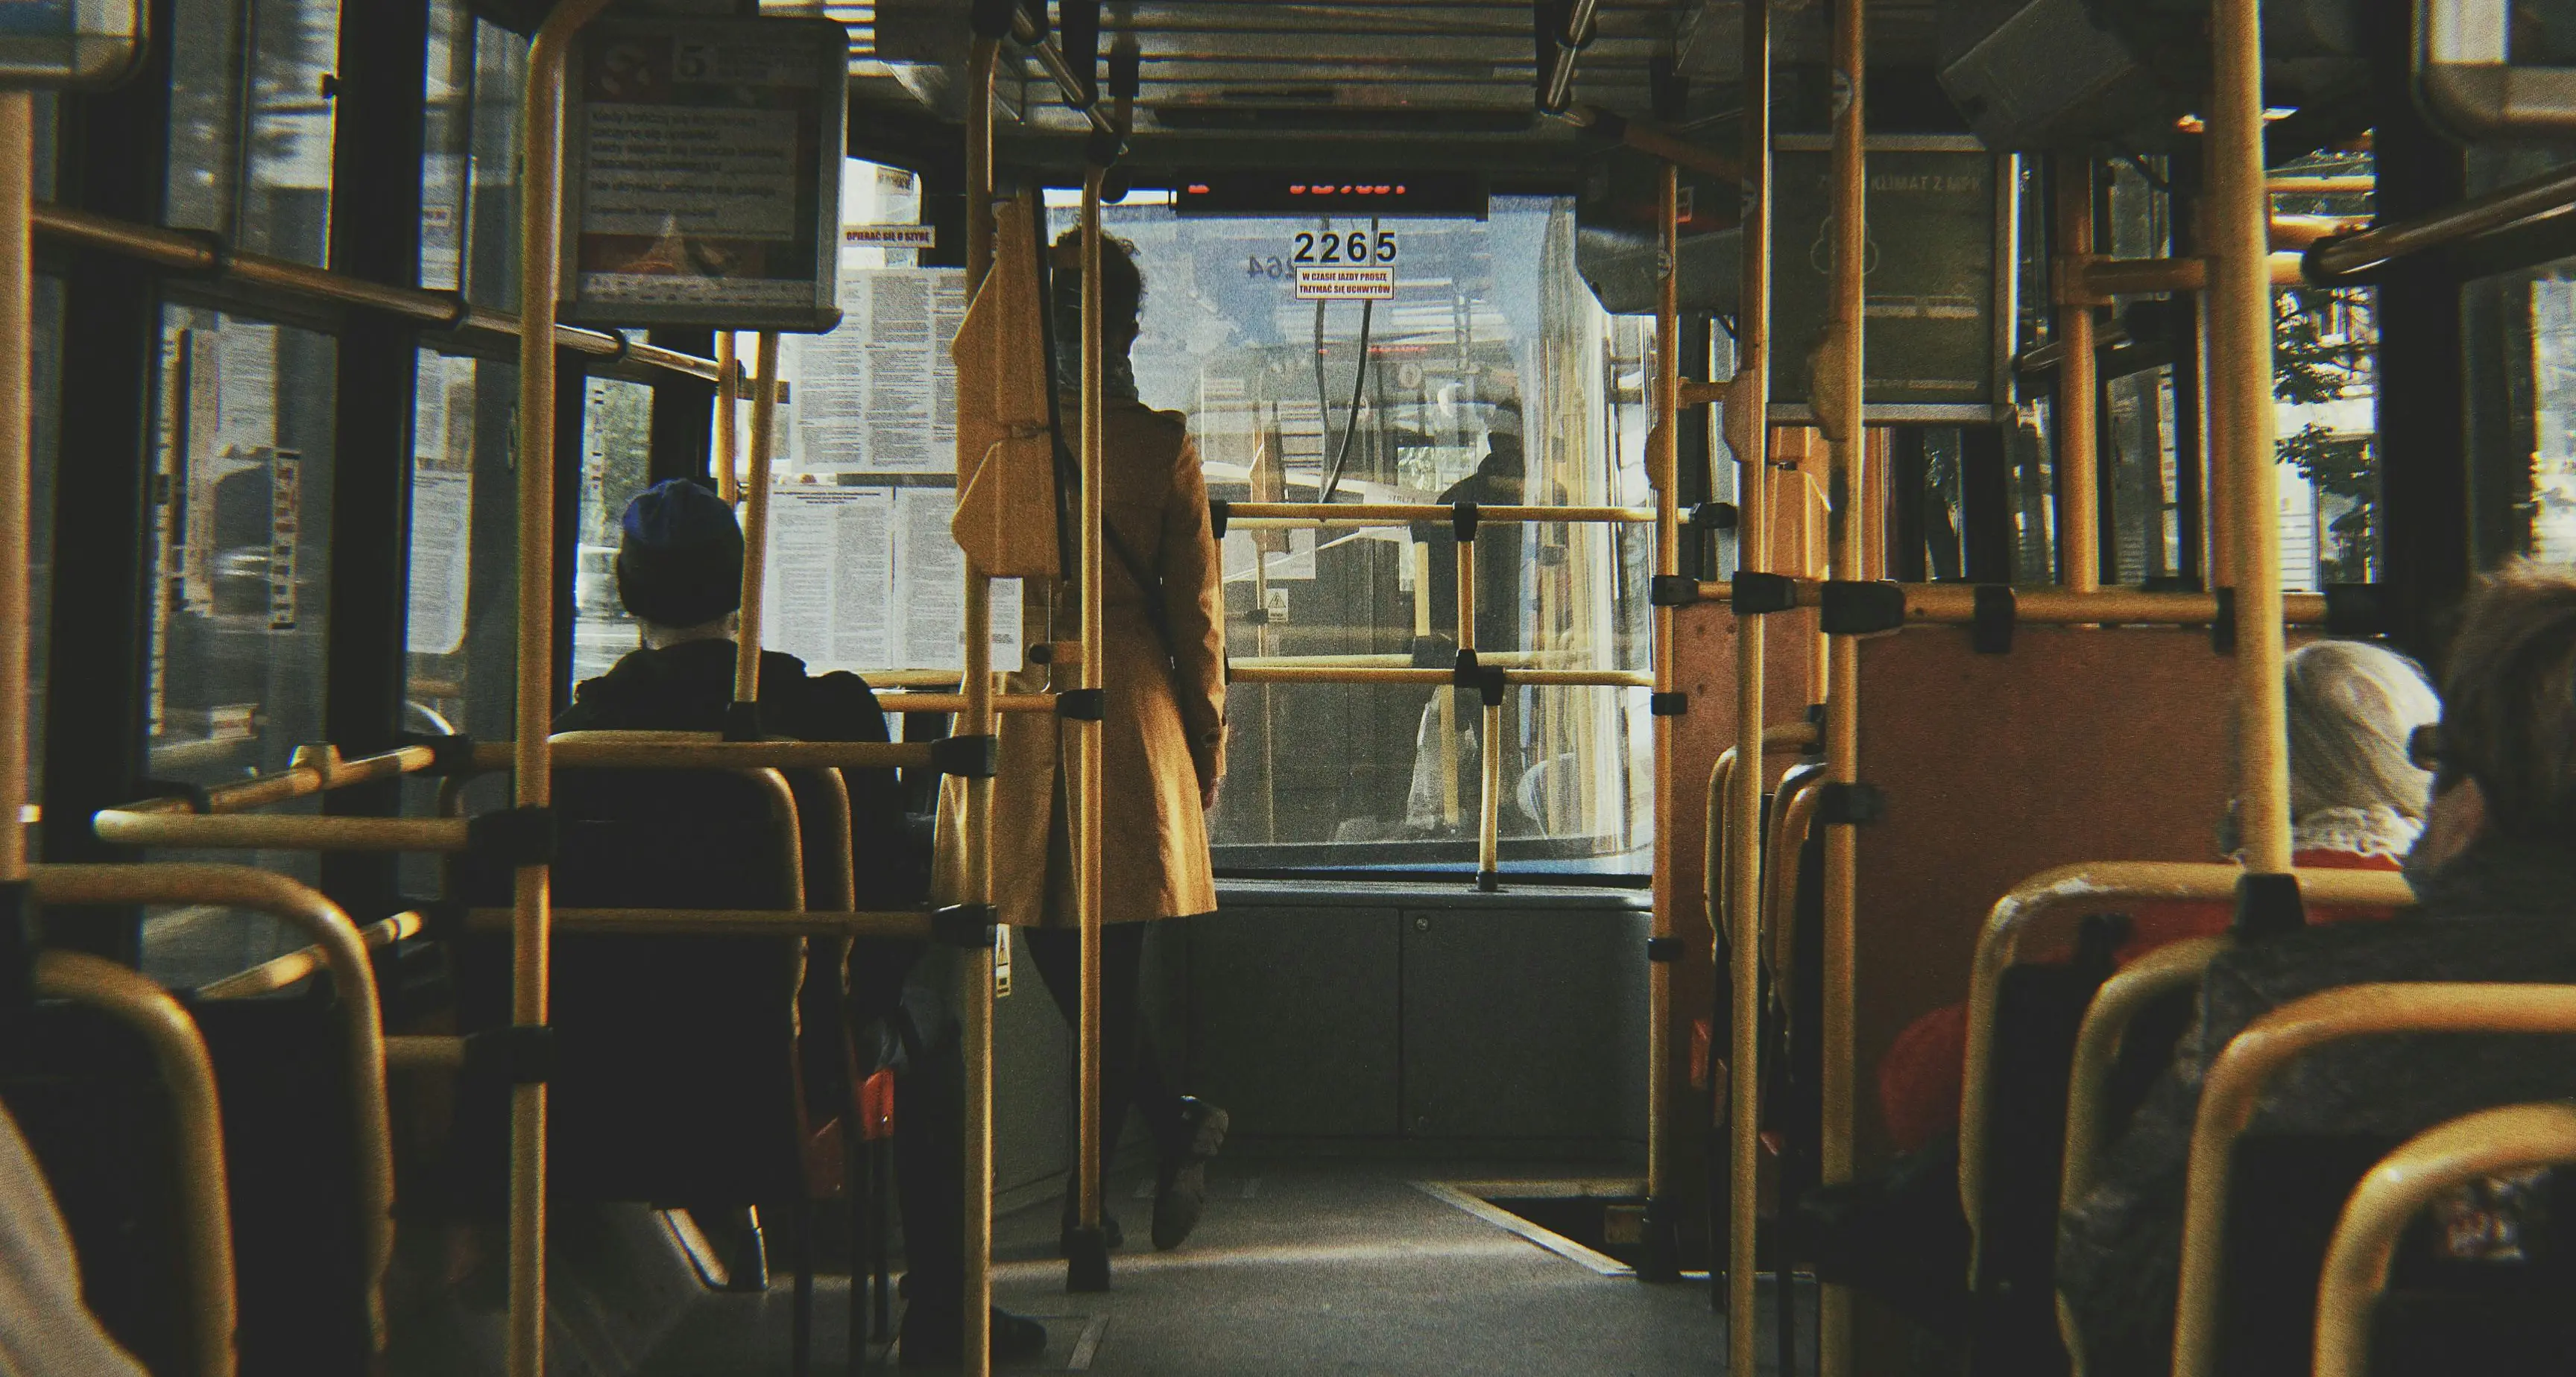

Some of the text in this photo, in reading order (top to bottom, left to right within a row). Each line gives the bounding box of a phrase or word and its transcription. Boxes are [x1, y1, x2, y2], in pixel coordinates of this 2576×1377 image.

[678, 45, 707, 78] 5
[1295, 232, 1396, 262] 2265
[1302, 272, 1387, 282] W CZASIE JAZDY PROSZĘ
[1300, 284, 1390, 294] TRZYMAĆ SIĘ UCHWYTÓW
